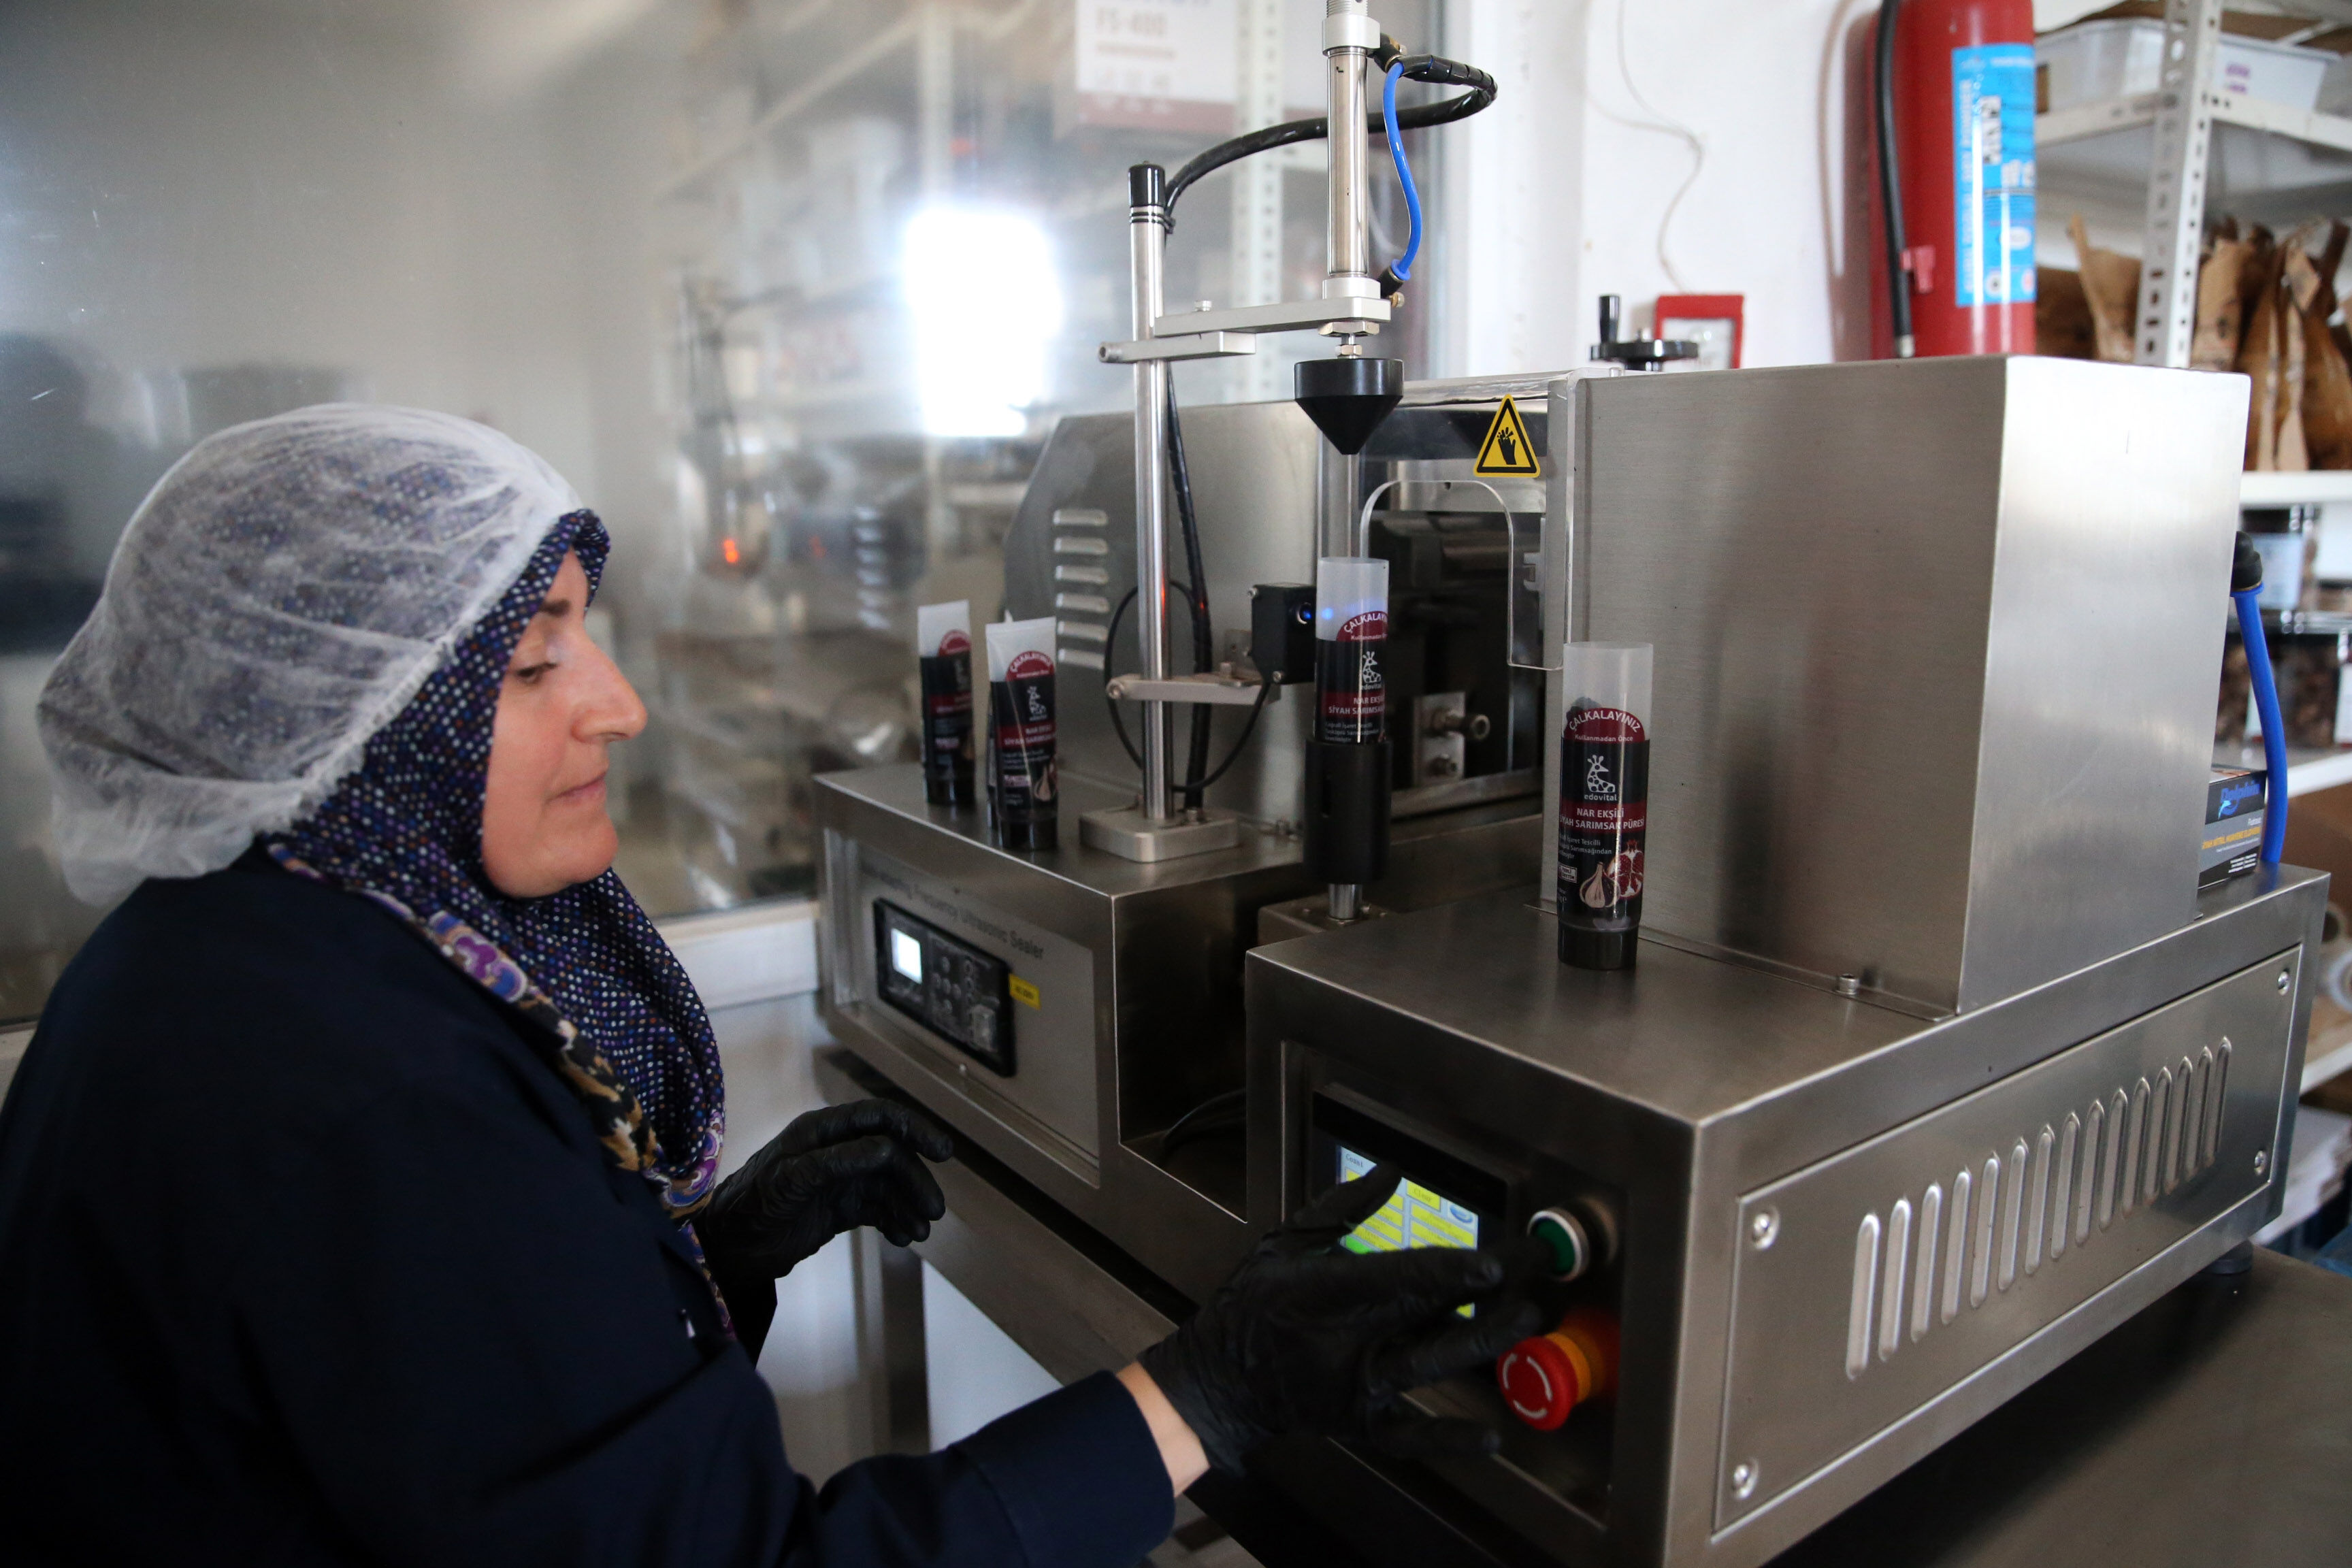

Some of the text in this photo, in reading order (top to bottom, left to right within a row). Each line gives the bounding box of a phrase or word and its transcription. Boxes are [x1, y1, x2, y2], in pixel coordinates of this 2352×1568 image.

[1328, 705, 1384, 715] SİYAH SARIMSA
[1569, 710, 1641, 732] ÇALKALAYINIZ
[1584, 794, 1618, 802] edovital
[1577, 808, 1624, 820] NAR EKŞİLİ
[1575, 819, 1620, 830] SARIMSAK
[1623, 816, 1645, 829] PÜRESİ
[1009, 930, 1044, 959] Sealer
[1345, 1153, 1364, 1168] Count
